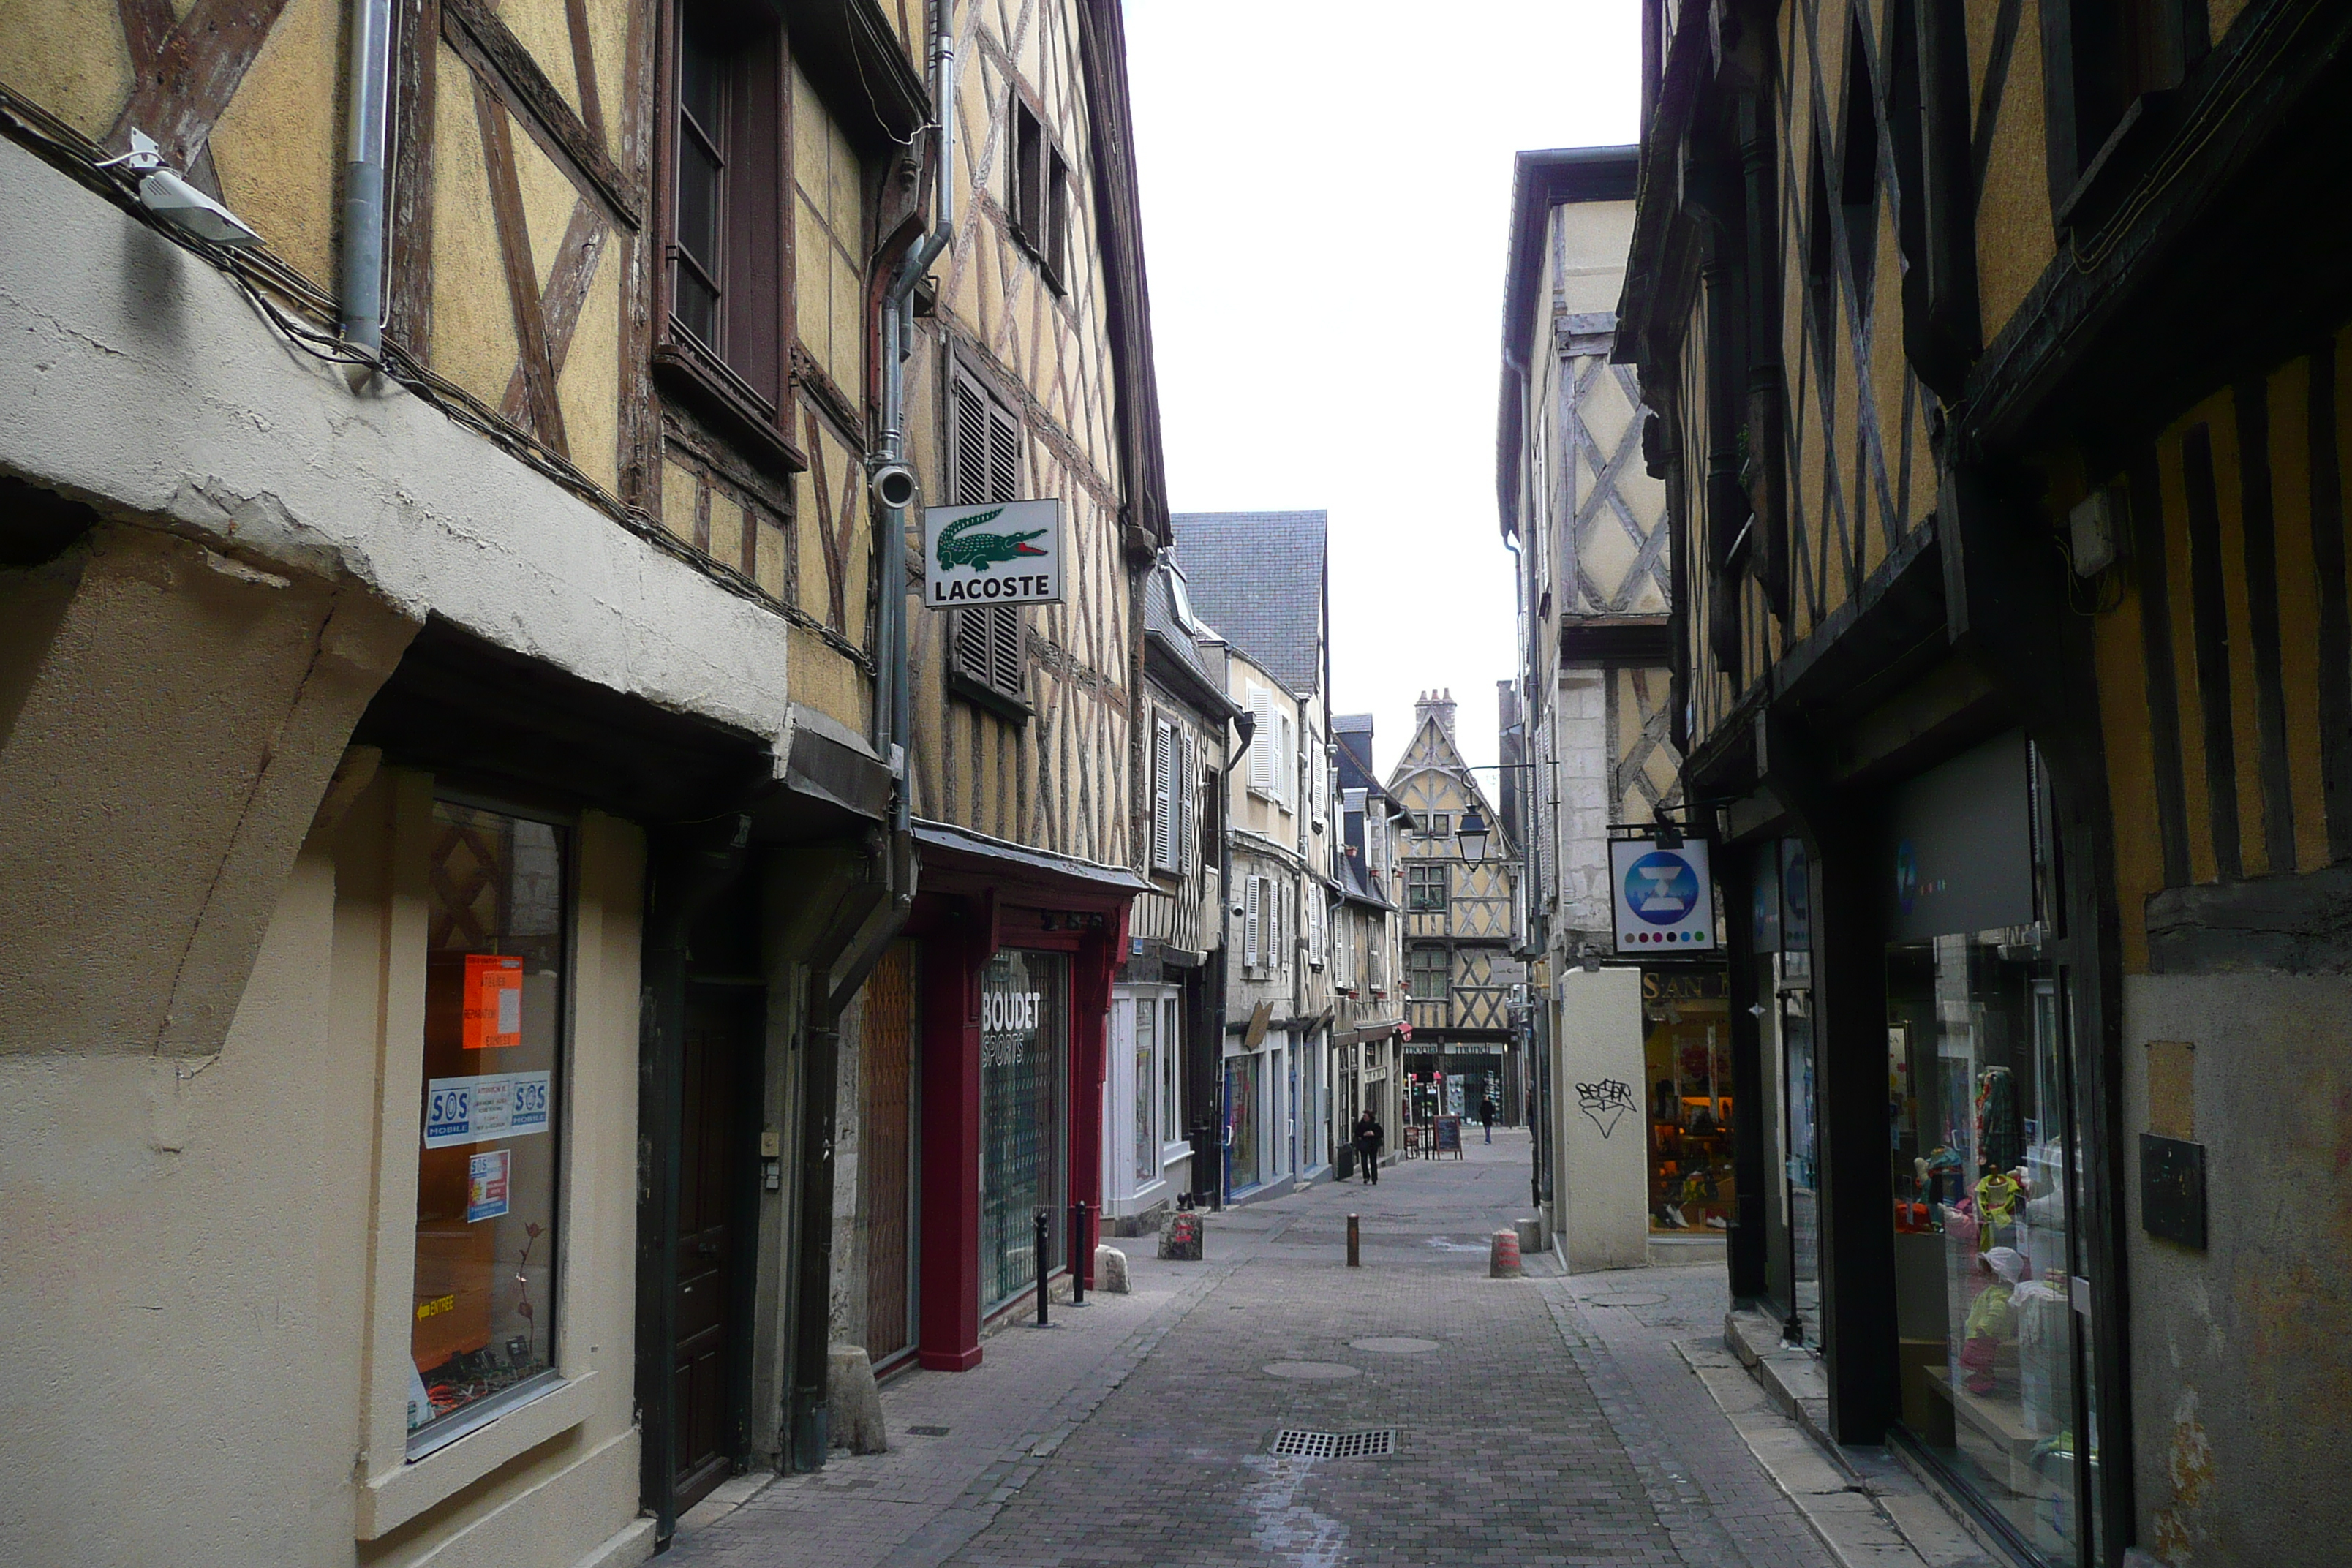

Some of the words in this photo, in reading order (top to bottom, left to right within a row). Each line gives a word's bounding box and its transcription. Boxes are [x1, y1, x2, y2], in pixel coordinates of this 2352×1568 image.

[935, 575, 1049, 601] LACOSTE
[1643, 972, 1704, 998] SAN
[982, 991, 1040, 1032] BOUDET
[982, 1033, 1024, 1068] SPORTS
[1455, 1044, 1491, 1054] mundi
[431, 1091, 468, 1121] SOS
[515, 1085, 545, 1111] SOS
[429, 1124, 467, 1135] MOBILE
[513, 1114, 546, 1123] MOBILE
[430, 1294, 454, 1316] ENTREE
